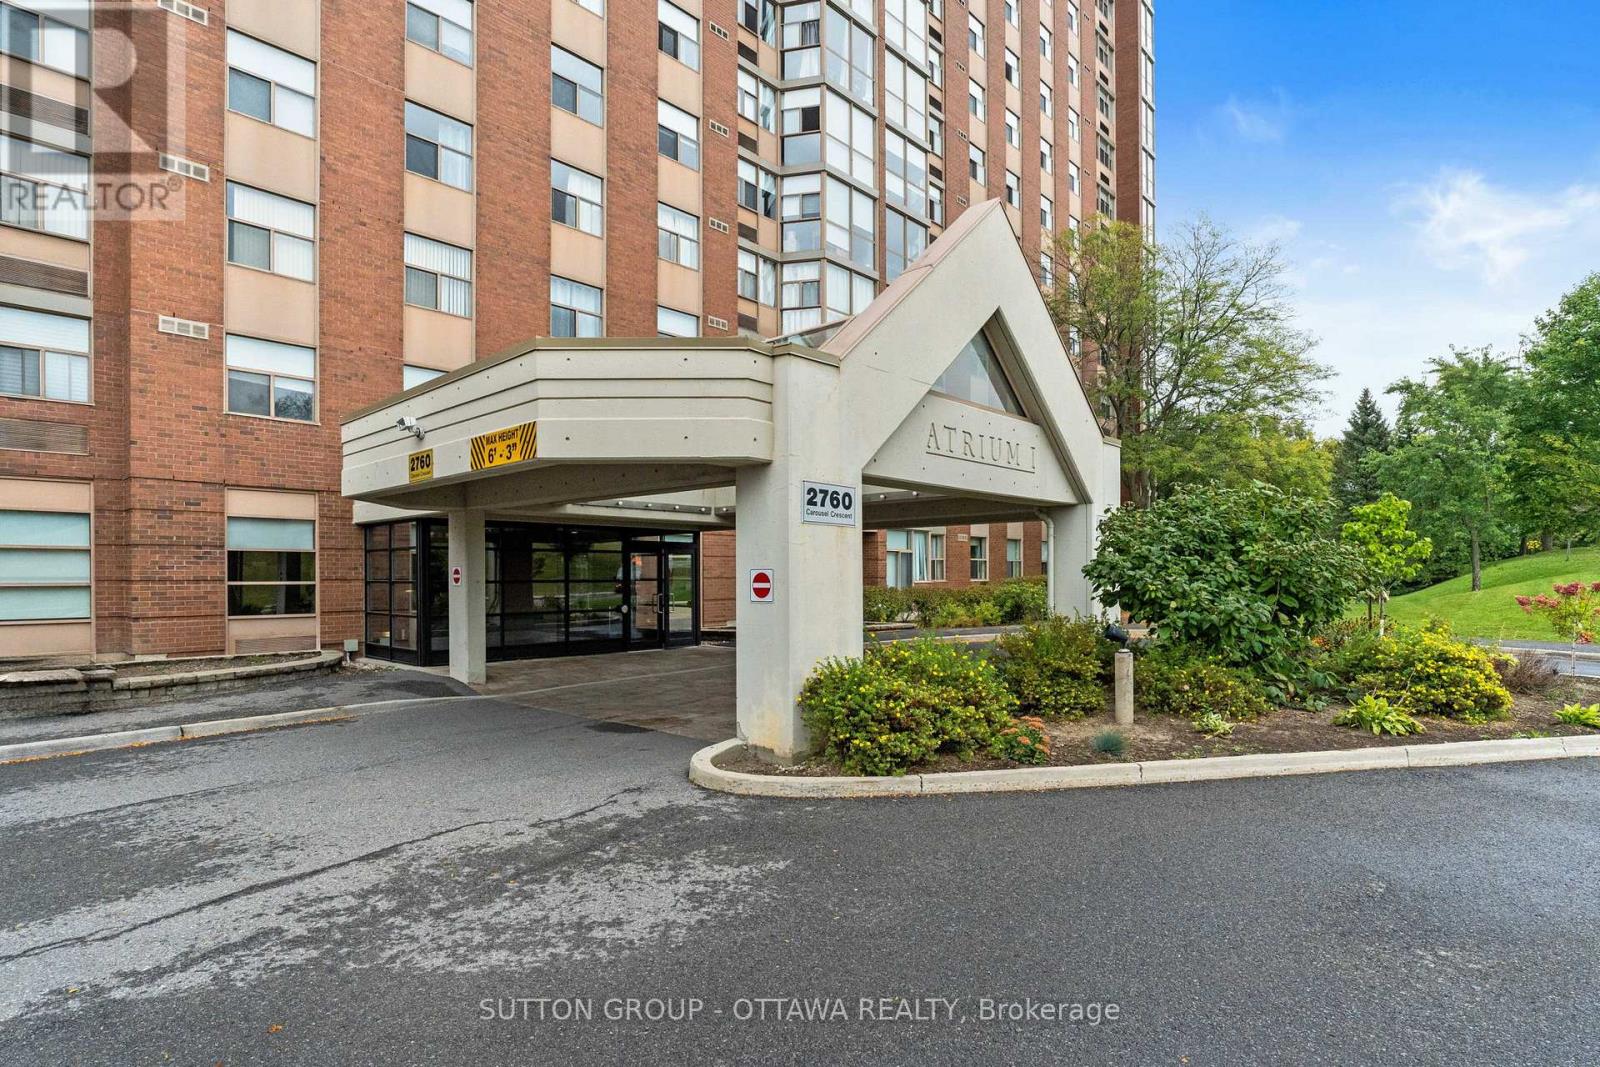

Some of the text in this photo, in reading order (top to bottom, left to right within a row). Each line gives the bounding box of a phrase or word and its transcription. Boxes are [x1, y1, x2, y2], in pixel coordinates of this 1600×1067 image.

[485, 428, 519, 446] MAX HEIGHT
[926, 422, 1020, 466] ATRIUM
[410, 453, 431, 472] 2760
[806, 487, 853, 511] 2760
[805, 508, 853, 520] Carousel Crescent
